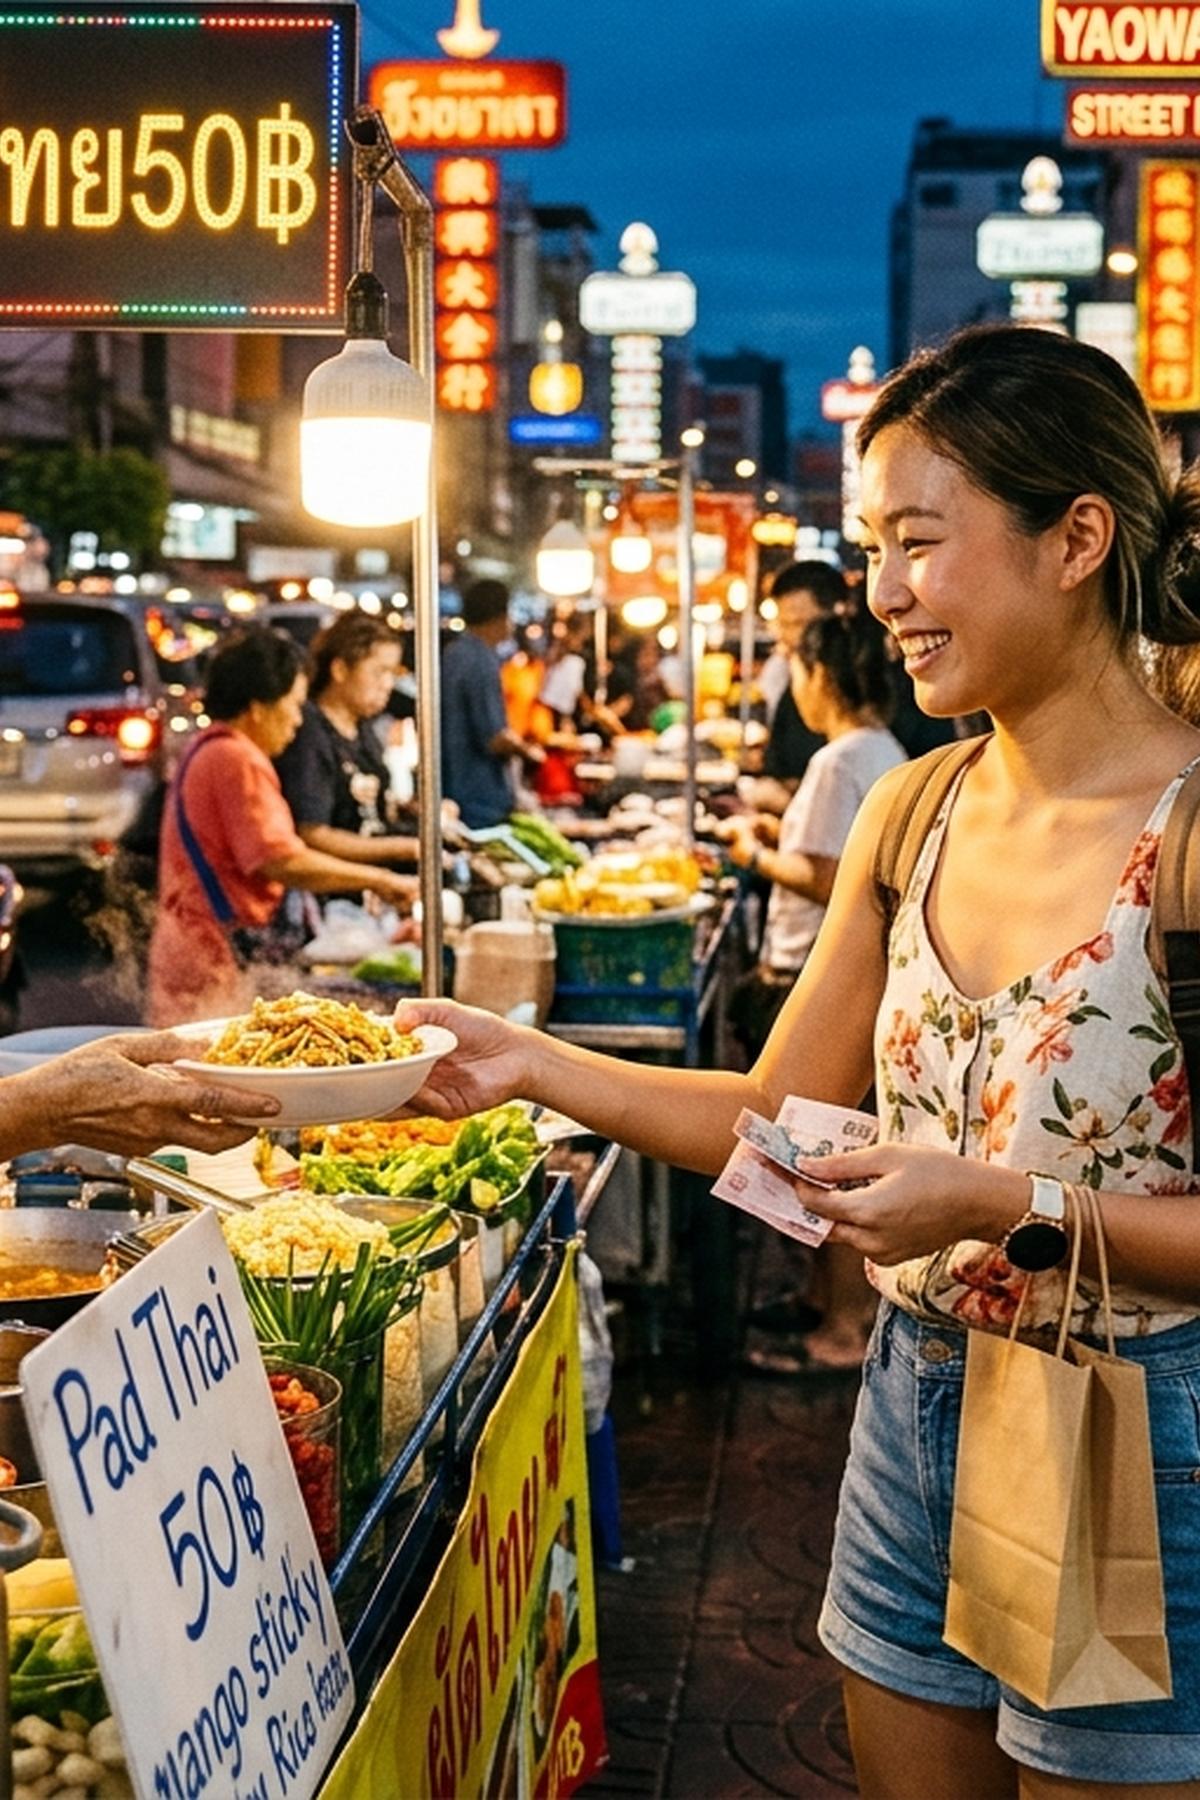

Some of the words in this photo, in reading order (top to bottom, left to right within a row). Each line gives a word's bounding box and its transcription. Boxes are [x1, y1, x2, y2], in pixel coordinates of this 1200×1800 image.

[1071, 93, 1191, 137] STREET
[53, 1328, 157, 1516] Pad
[131, 1265, 239, 1421] Thai
[159, 1449, 265, 1641] 50฿
[249, 1542, 327, 1699] sticky
